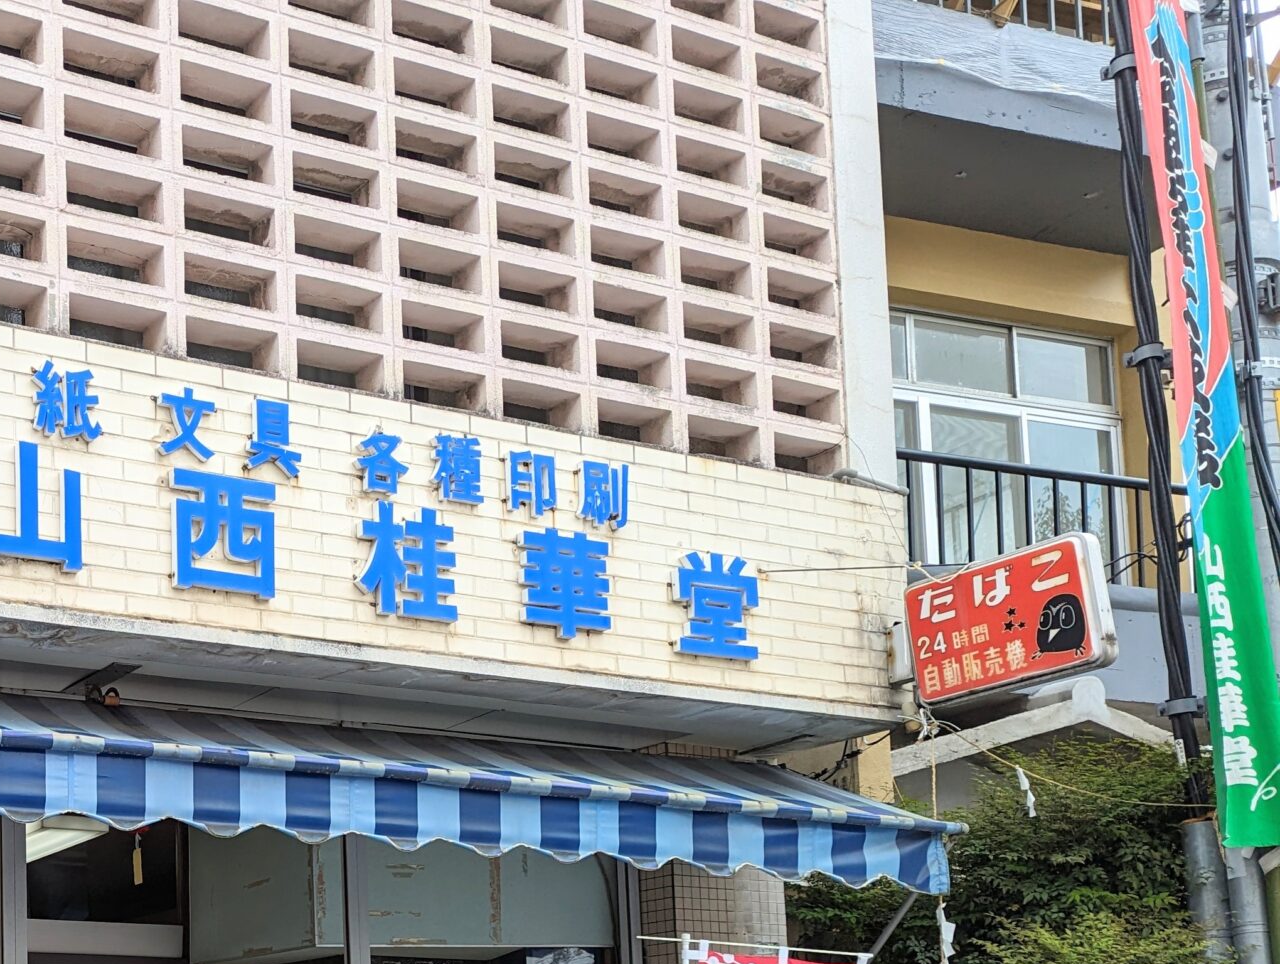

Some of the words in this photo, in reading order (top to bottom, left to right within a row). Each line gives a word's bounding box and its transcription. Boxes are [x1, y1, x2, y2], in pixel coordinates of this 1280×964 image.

[32, 361, 102, 442] 紙
[156, 386, 302, 478] 文具
[355, 427, 630, 531] 各種印刷
[917, 549, 1070, 624] たばこ
[923, 639, 1029, 695] 自動販売機
